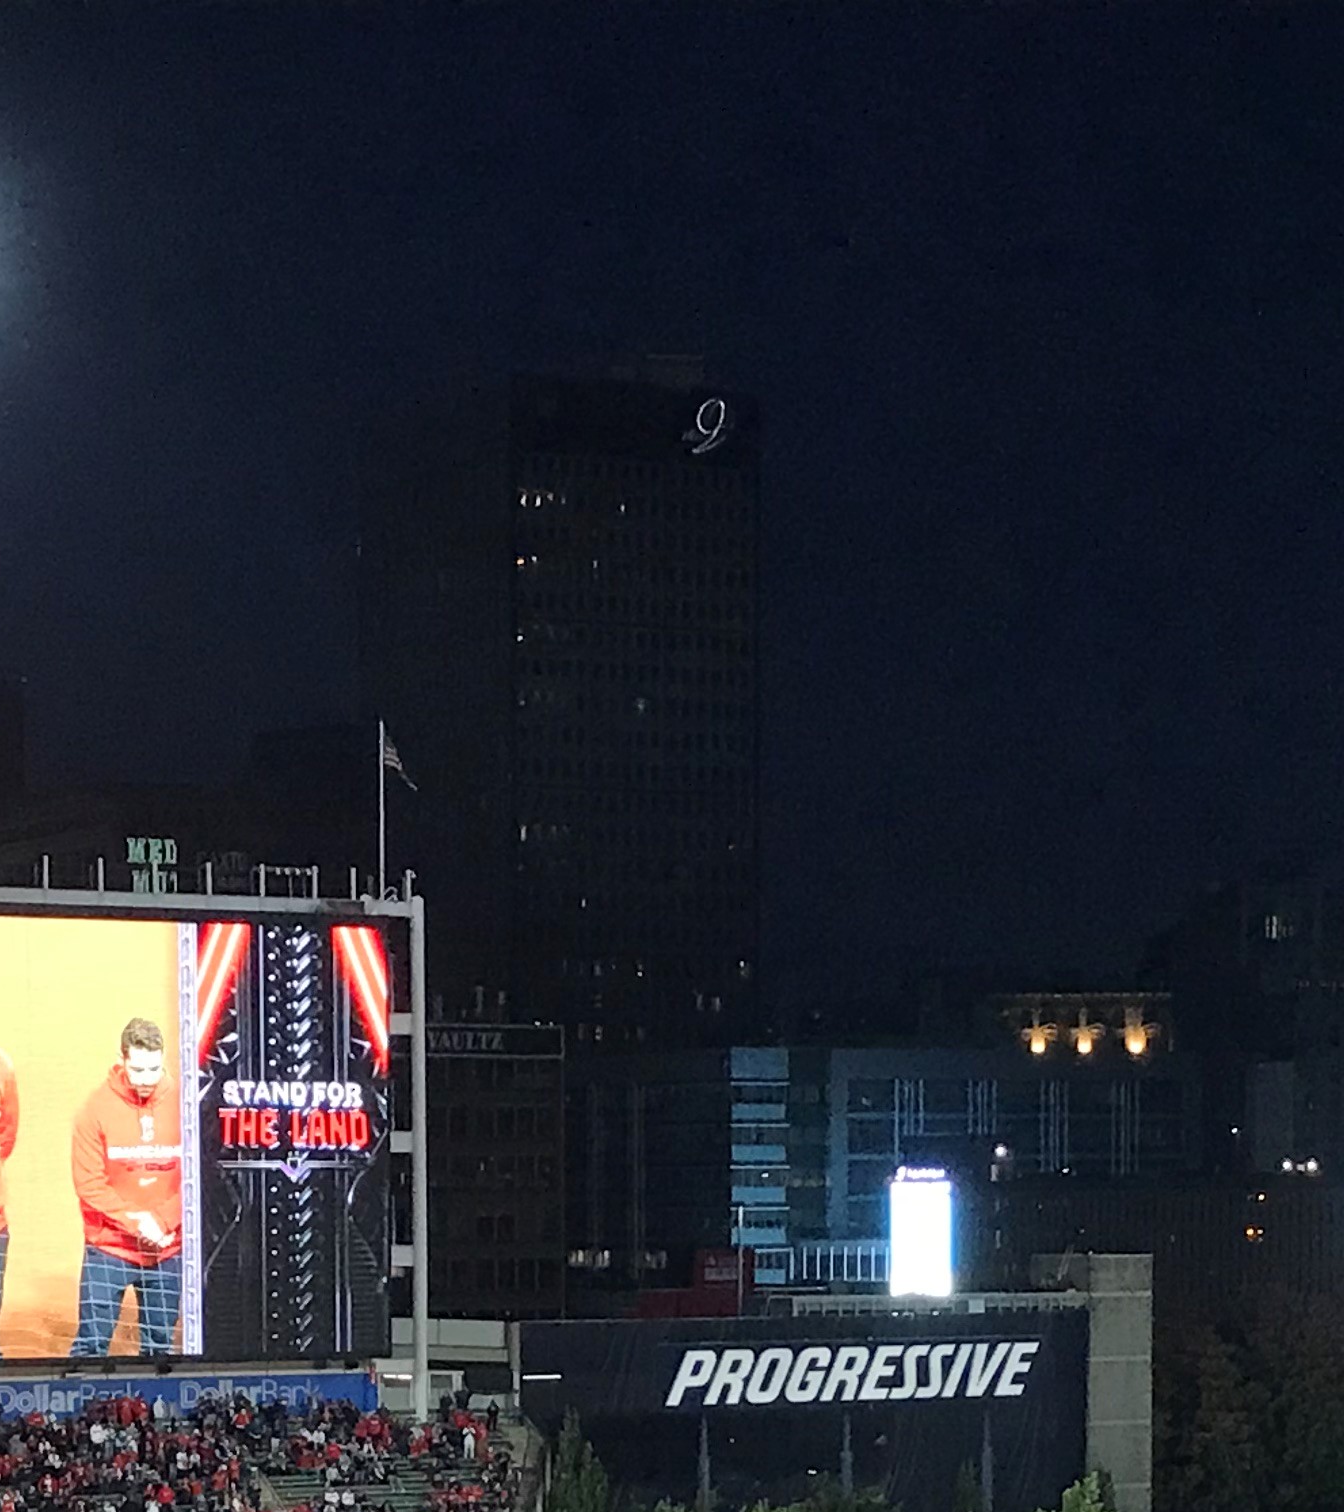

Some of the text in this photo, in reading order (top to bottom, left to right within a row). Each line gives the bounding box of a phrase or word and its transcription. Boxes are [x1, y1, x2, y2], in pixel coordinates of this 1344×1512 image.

[223, 1081, 363, 1107] STAND FOR
[218, 1108, 371, 1150] THE LAND
[665, 1341, 1040, 1407] PROGRESSIVE
